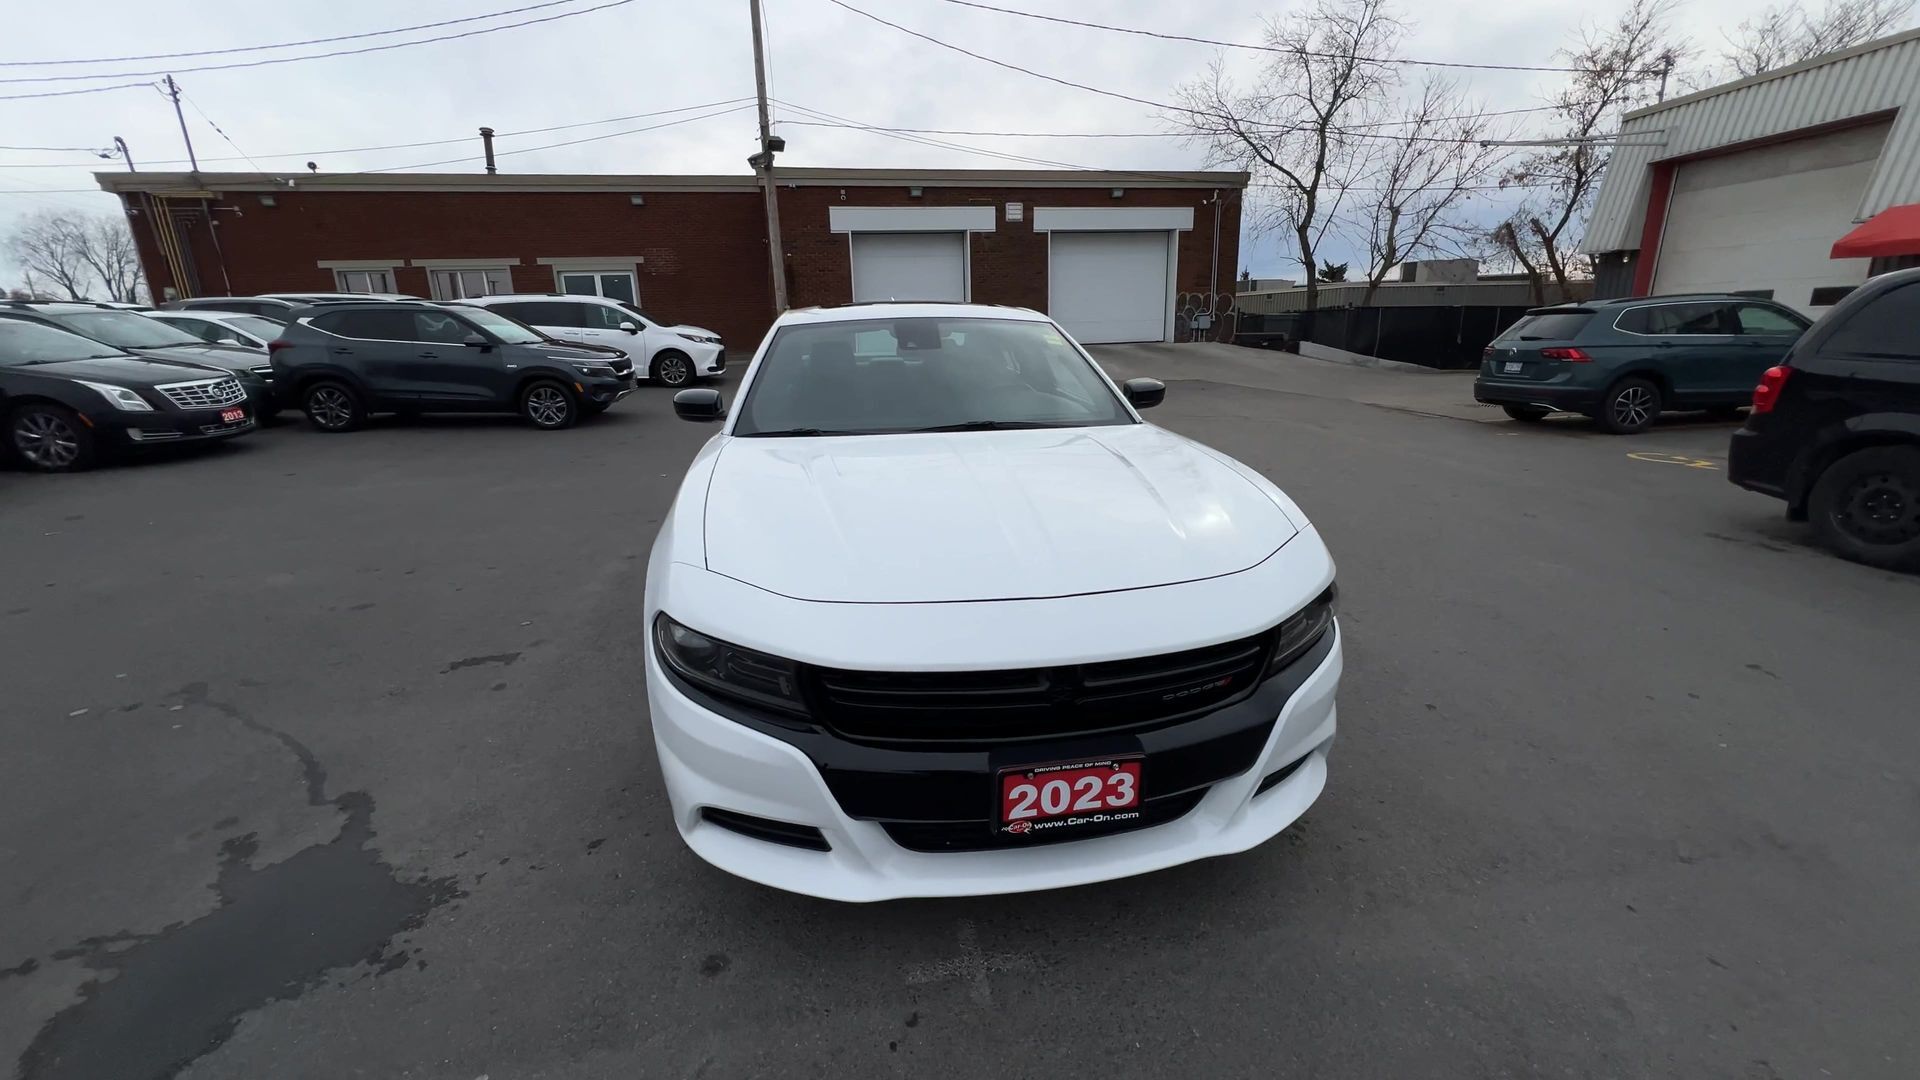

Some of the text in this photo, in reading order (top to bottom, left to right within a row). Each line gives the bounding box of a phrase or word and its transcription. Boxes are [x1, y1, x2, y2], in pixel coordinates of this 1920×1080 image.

[222, 410, 244, 421] 2013
[1008, 772, 1135, 820] 2023
[1034, 812, 1139, 830] www.Car-On.com
